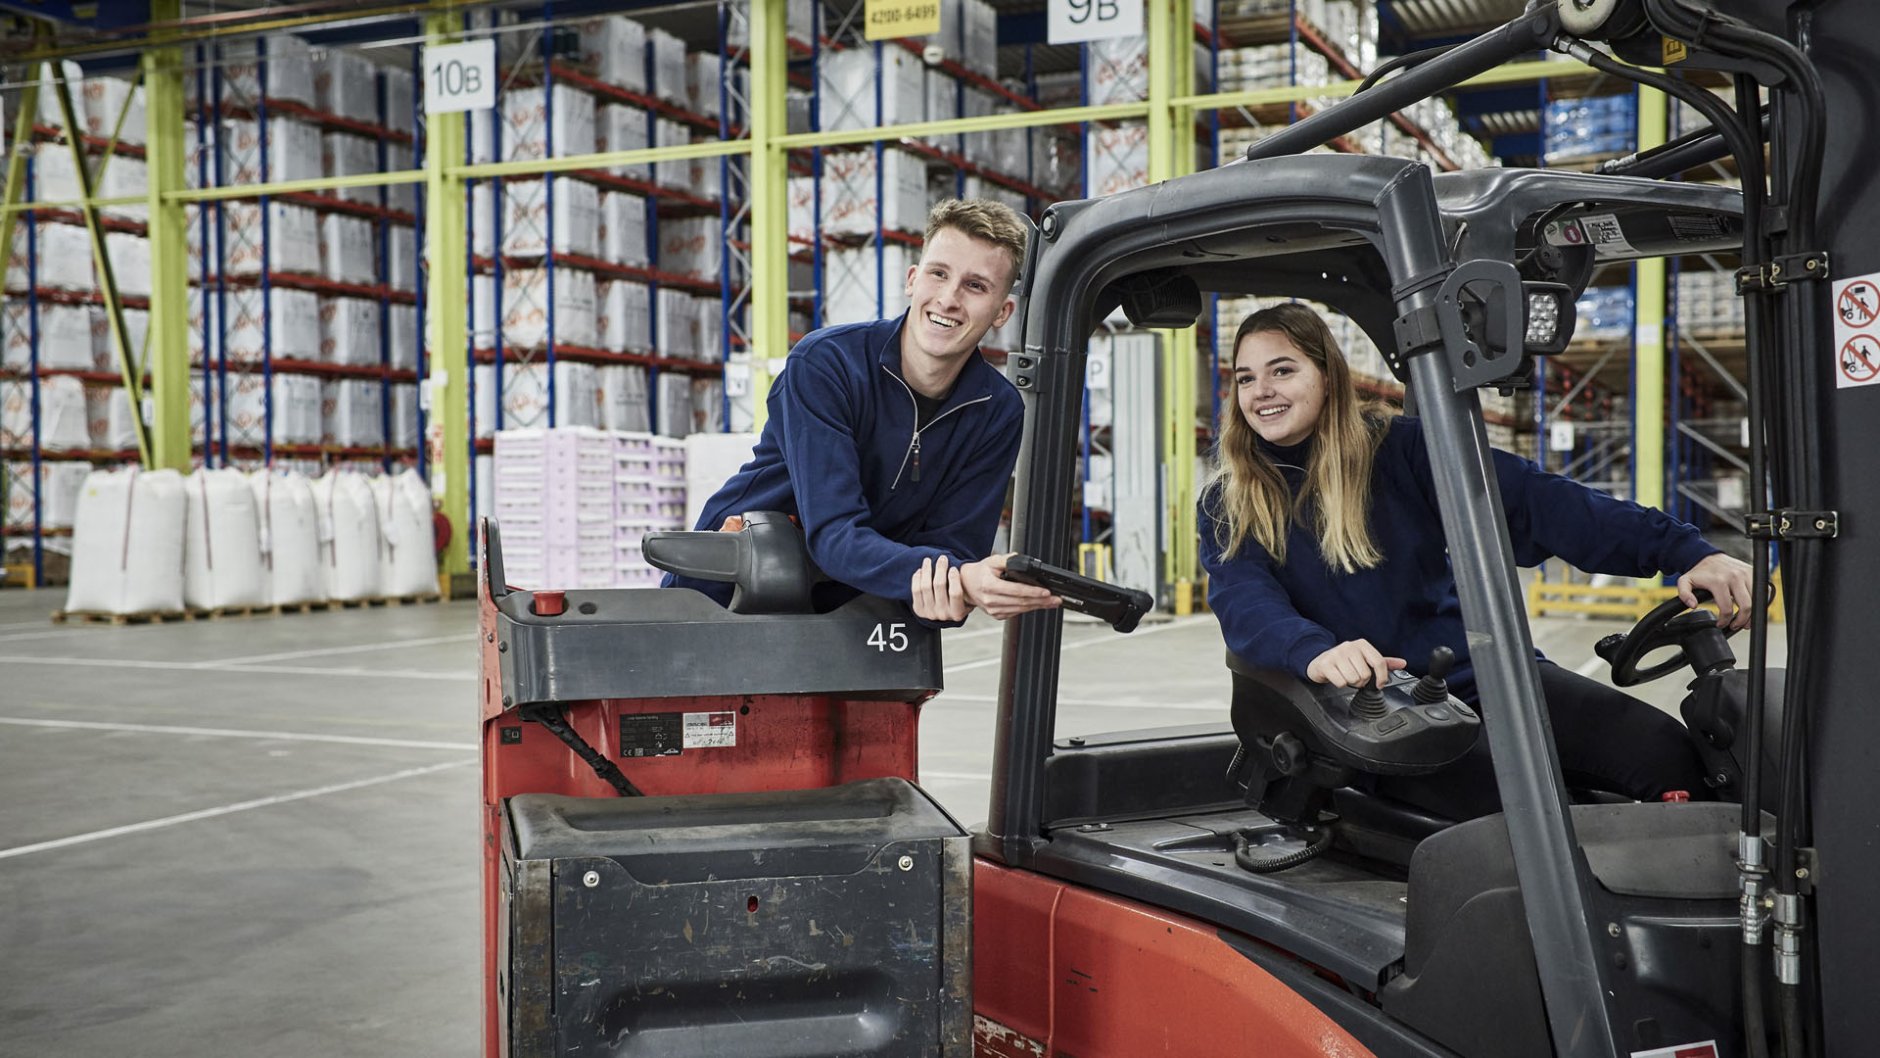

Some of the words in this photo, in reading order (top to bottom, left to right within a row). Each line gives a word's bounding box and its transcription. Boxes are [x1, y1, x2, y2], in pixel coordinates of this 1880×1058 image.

[1068, 0, 1119, 24] 9B
[432, 60, 482, 96] 10B
[867, 623, 908, 652] 45
